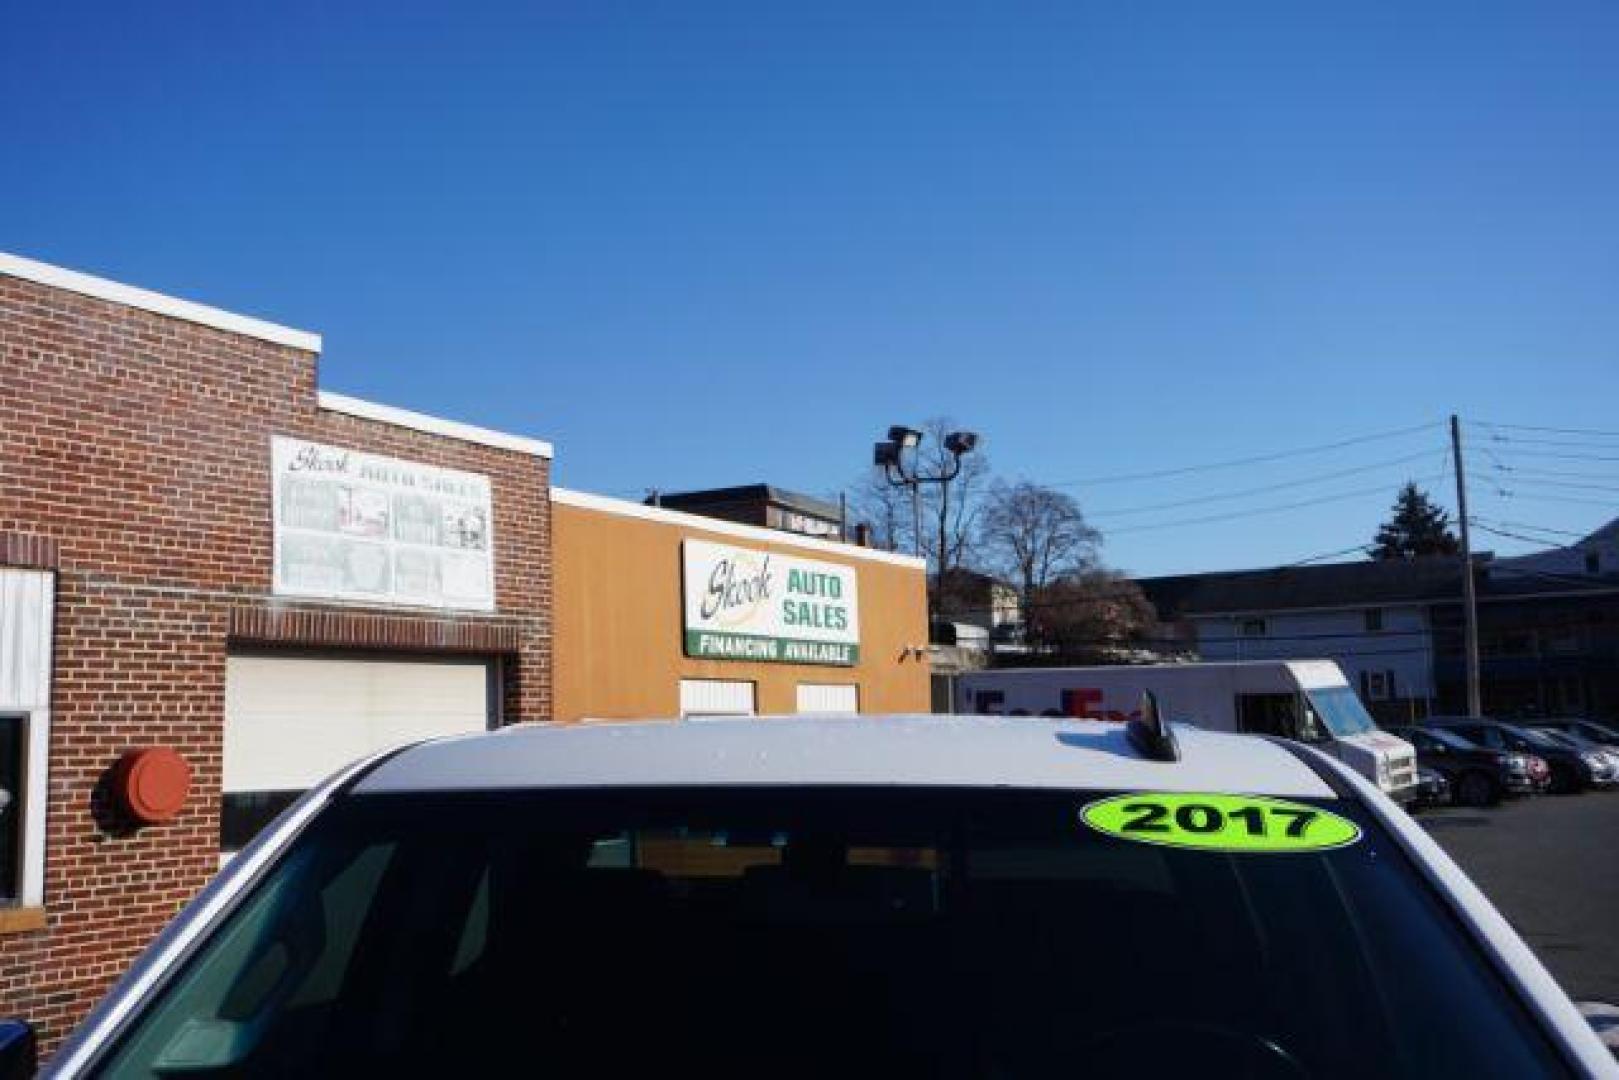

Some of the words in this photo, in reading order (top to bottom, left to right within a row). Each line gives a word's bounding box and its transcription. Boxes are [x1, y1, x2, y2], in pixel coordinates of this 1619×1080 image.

[787, 568, 842, 599] AUTO
[783, 599, 848, 631] SALES
[1120, 803, 1317, 838] 2017
